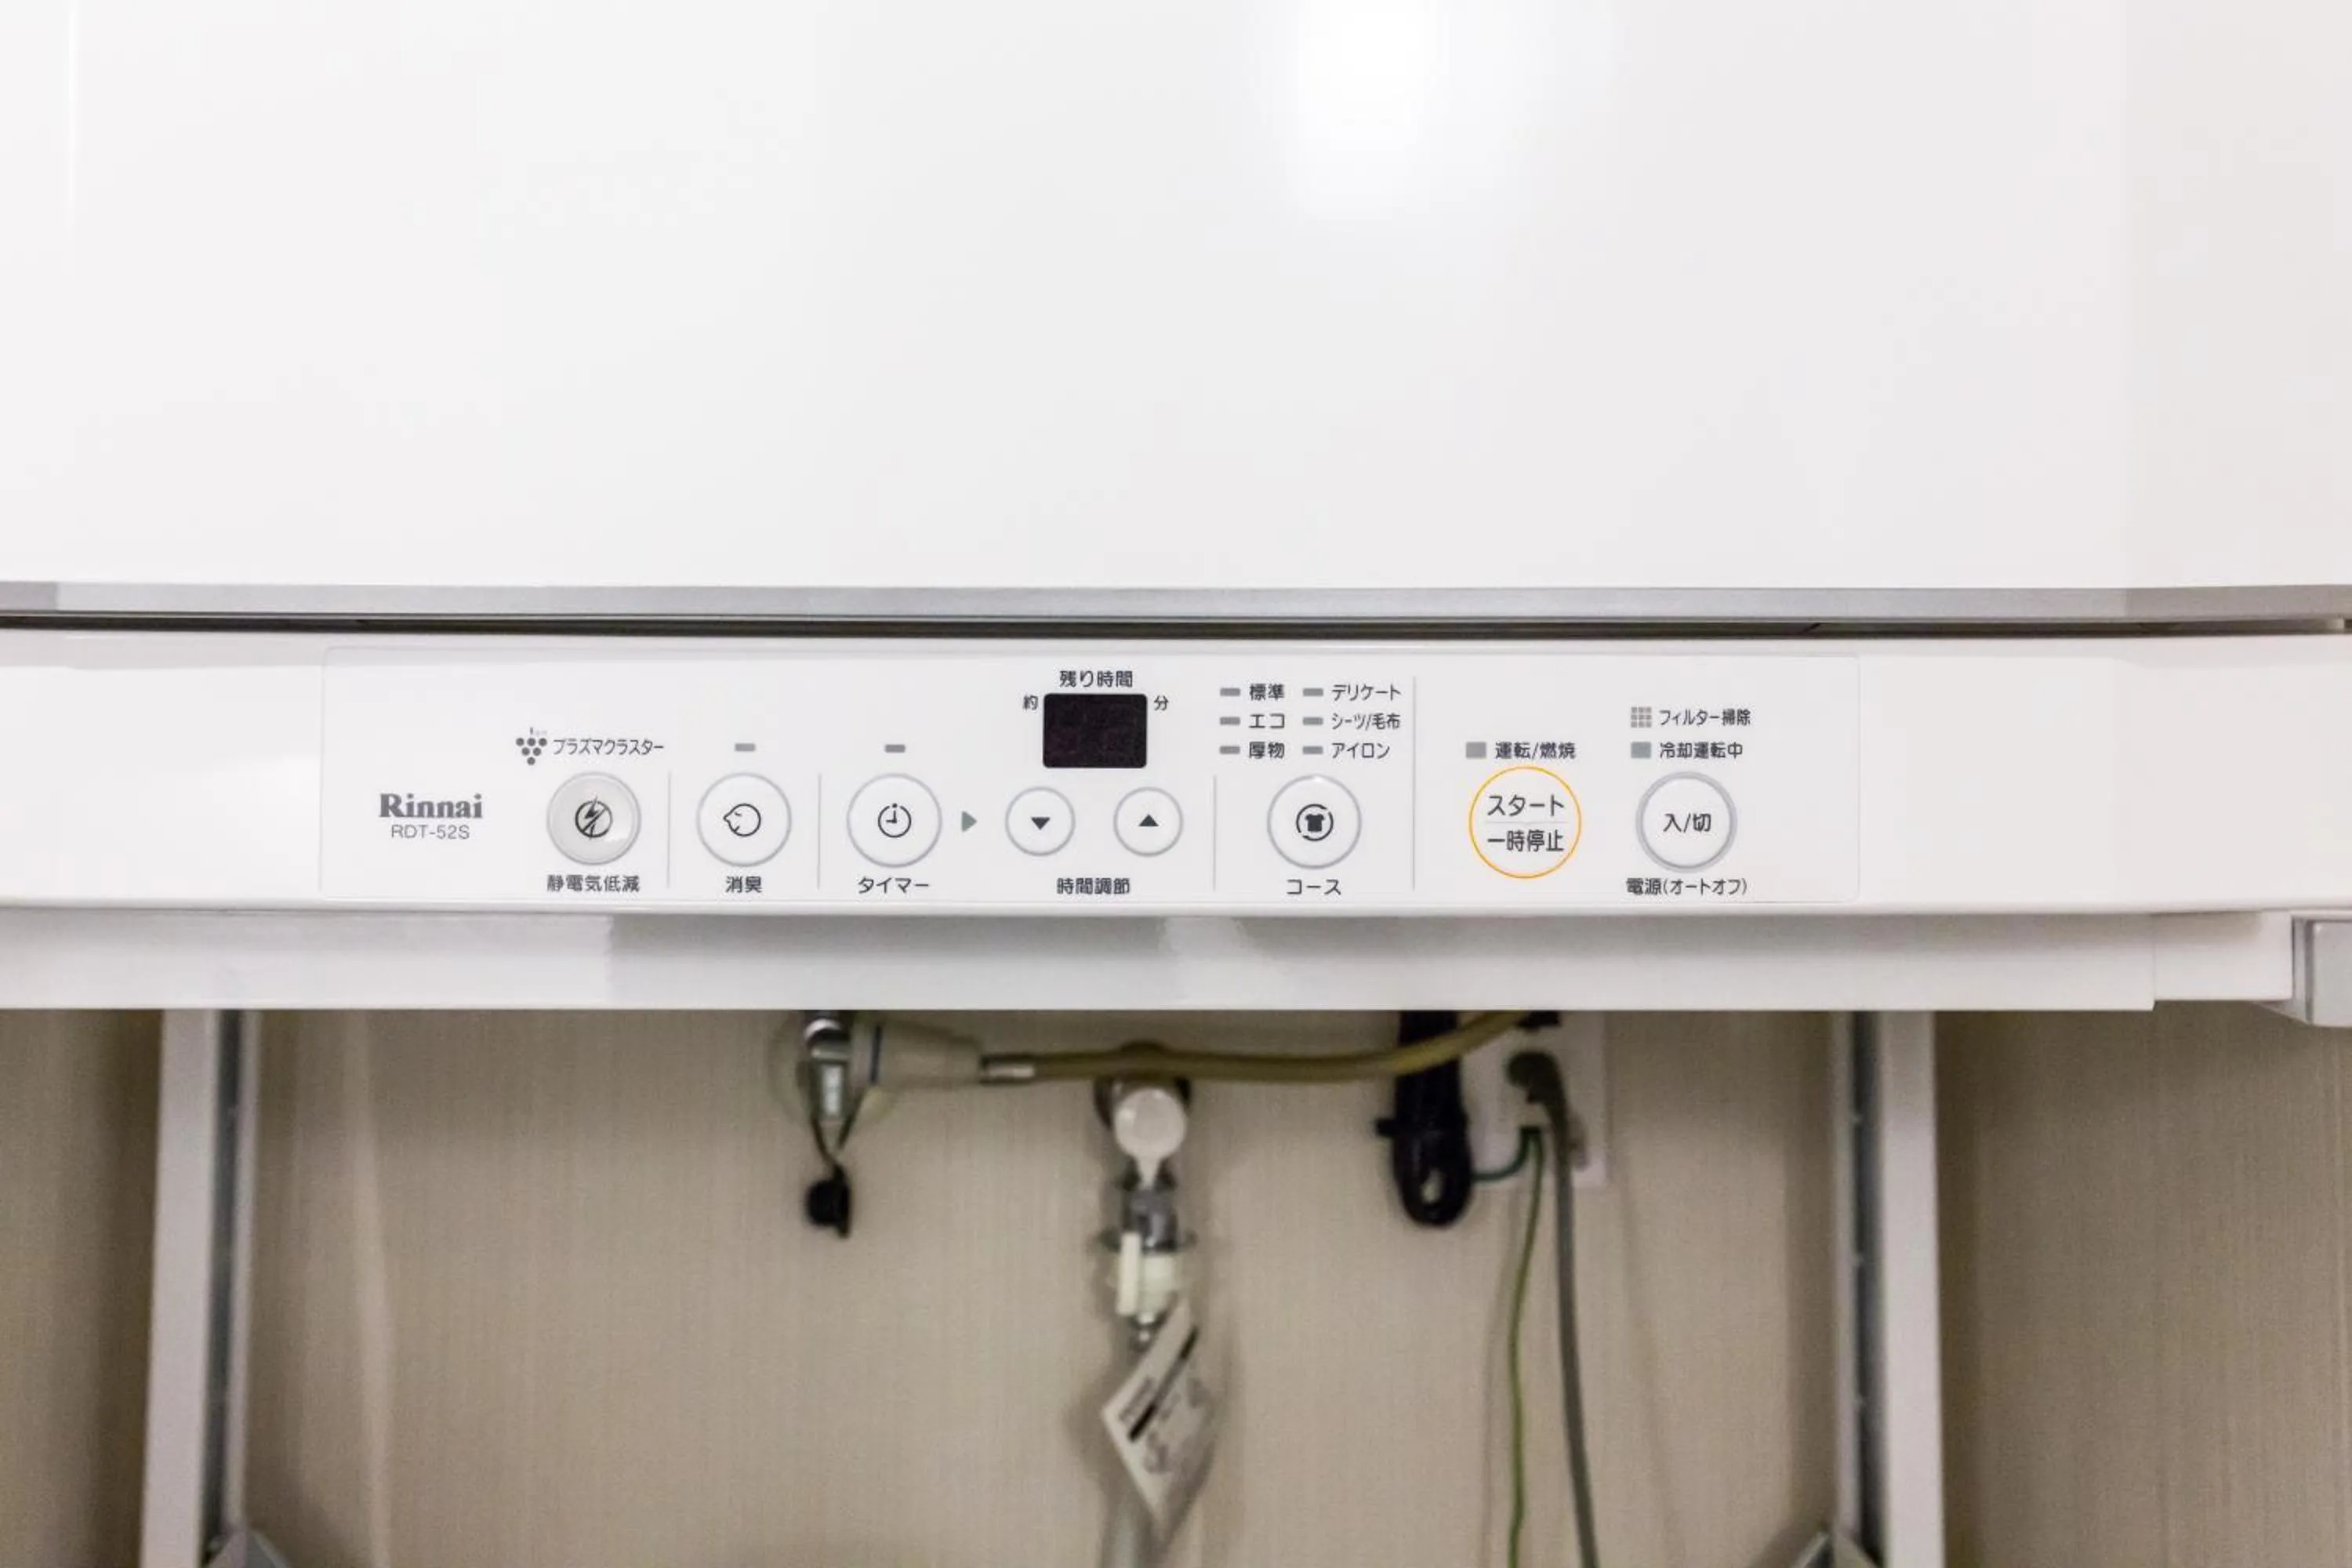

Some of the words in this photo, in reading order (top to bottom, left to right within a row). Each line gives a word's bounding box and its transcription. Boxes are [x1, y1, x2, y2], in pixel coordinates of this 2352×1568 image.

[1060, 670, 1133, 688] 残り時間
[1249, 684, 1284, 701] 標準
[1332, 684, 1401, 701] デリケート
[1023, 695, 1038, 710] 約
[1154, 695, 1169, 711] 分
[1249, 713, 1285, 729] エコ
[1332, 713, 1400, 731] シーツ/毛布
[1660, 709, 1751, 727] フィルター掃除
[554, 739, 664, 755] プラズマクラスター
[1249, 742, 1285, 760] 厚物
[1332, 742, 1390, 759] アイロン
[1660, 742, 1743, 759] 冷却運転中
[379, 793, 482, 818] Rinnai
[1487, 794, 1564, 817] スタート
[1663, 813, 1711, 833] 入/切
[391, 825, 470, 840] RDT-52S
[1487, 829, 1564, 852] 一時停止
[547, 875, 640, 892] 静電気低減
[725, 876, 762, 893] 消臭
[858, 877, 929, 894] タイマー
[1057, 878, 1130, 895] 時間調節
[1287, 879, 1341, 895] コース
